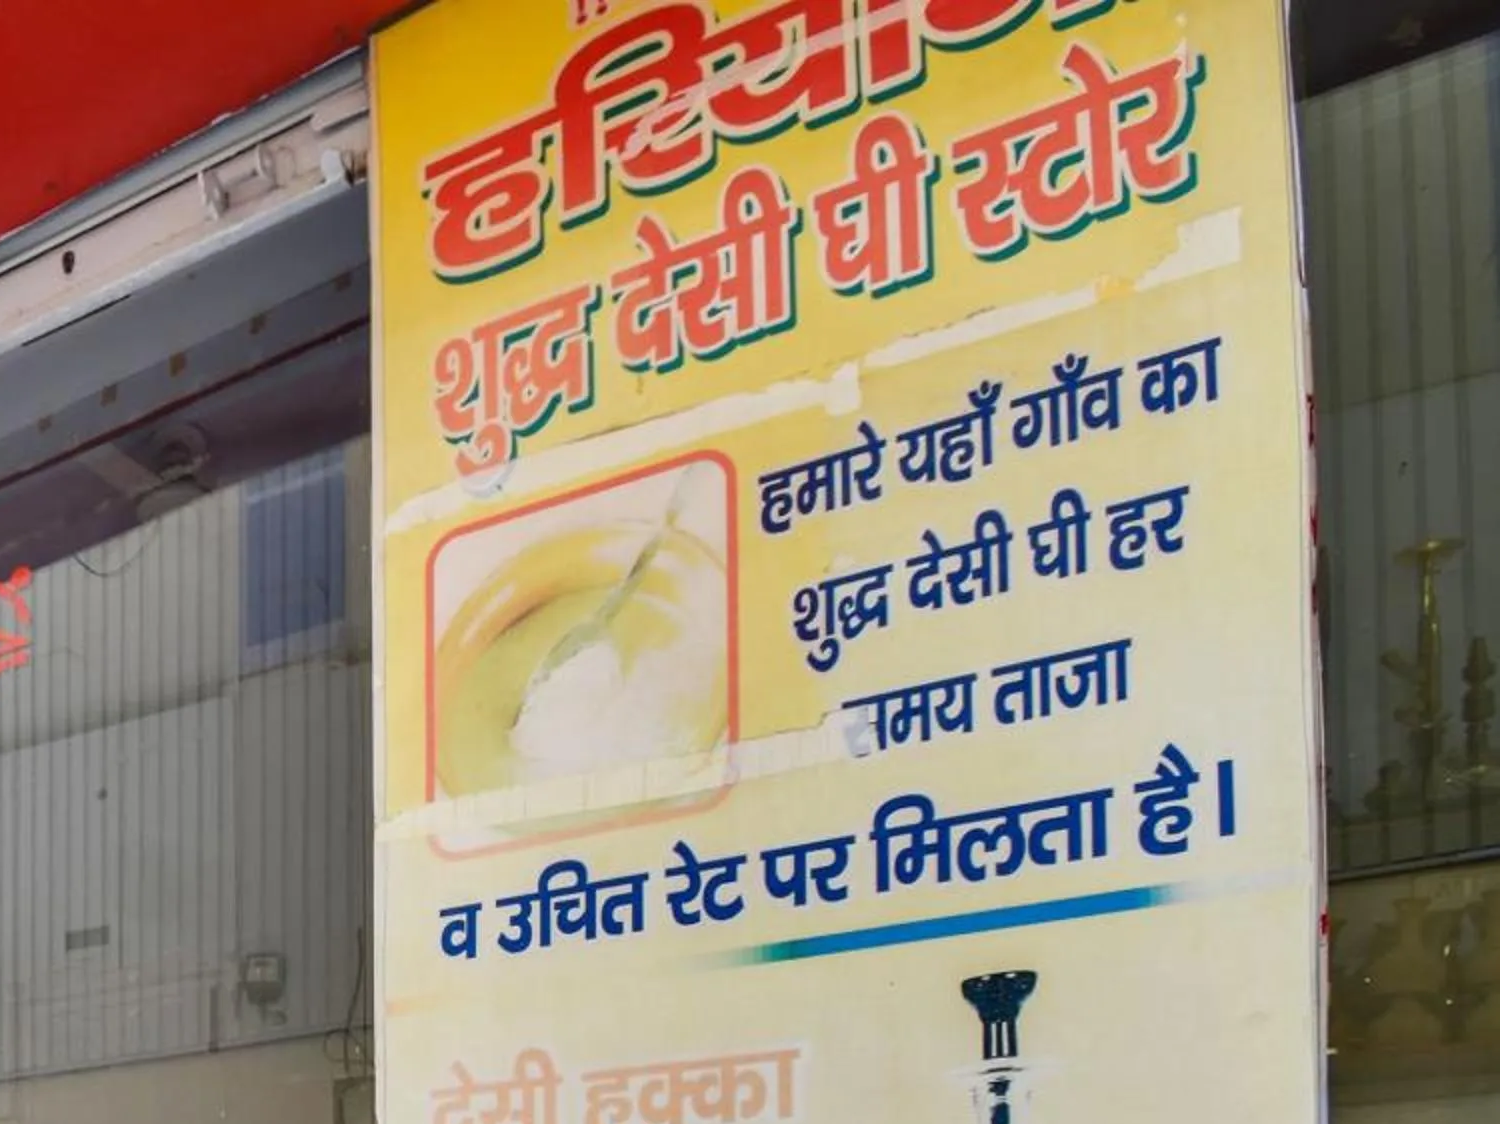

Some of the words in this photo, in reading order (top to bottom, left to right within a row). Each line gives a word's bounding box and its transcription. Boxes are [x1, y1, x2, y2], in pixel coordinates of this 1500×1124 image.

[611, 165, 802, 373] देसी
[814, 110, 936, 301] घी
[953, 43, 1206, 262] स्टोर
[760, 421, 887, 534] हमारे
[896, 380, 1003, 484] यहाँ
[1137, 336, 1222, 414] का
[792, 556, 891, 671] शुद्ध
[906, 511, 1016, 615] देसी
[1027, 490, 1091, 581] घी
[1106, 483, 1191, 572] हर
[992, 637, 1132, 722] ताजा
[439, 899, 479, 962] व
[496, 859, 649, 958] उचित
[665, 840, 745, 929] रेट
[760, 832, 852, 912] पर
[869, 784, 1112, 896] मिलता
